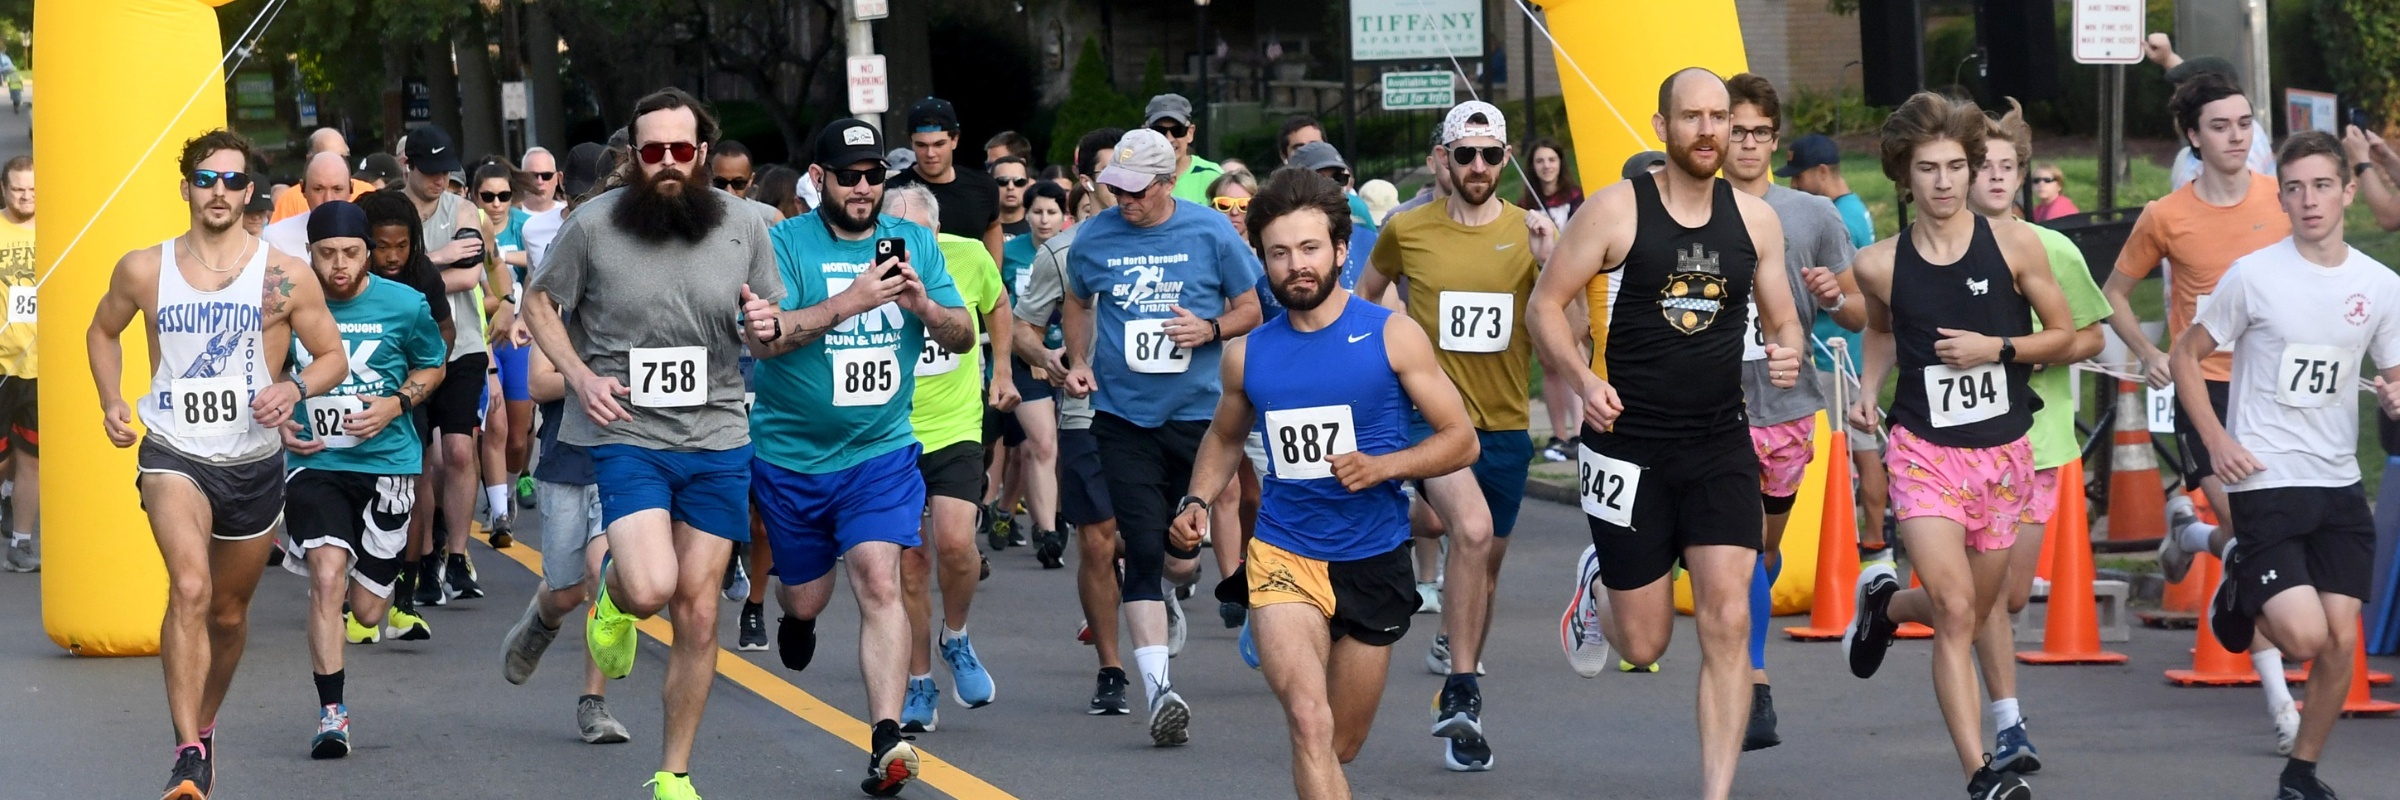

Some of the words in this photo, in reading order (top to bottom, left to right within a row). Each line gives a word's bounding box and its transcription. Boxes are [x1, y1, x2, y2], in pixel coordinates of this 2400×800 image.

[1358, 12, 1475, 32] TIFFANY
[1360, 33, 1476, 44] APARTMENTS
[861, 64, 873, 74] NO
[852, 76, 885, 86] PARKING
[1387, 78, 1427, 88] Available
[1430, 78, 1450, 86] Now
[1387, 93, 1409, 104] Call
[1428, 92, 1450, 104] Info
[1107, 258, 1122, 268] The
[1123, 255, 1147, 266] North
[1148, 253, 1189, 265] Boroughs
[1112, 283, 1132, 297] 5K
[1155, 281, 1184, 293] RUN
[157, 301, 262, 335] ASSUMPTION
[1451, 305, 1502, 339] 873
[824, 334, 856, 346] RUN
[856, 334, 870, 346] &
[870, 331, 902, 345] WALK
[642, 359, 696, 394] 758
[845, 360, 892, 393] 885
[2289, 358, 2340, 395] 751
[342, 380, 385, 396] WALK
[1938, 371, 1998, 413] 794
[183, 390, 237, 424] 889
[1279, 422, 1340, 465] 887
[1581, 461, 1625, 511] 842
